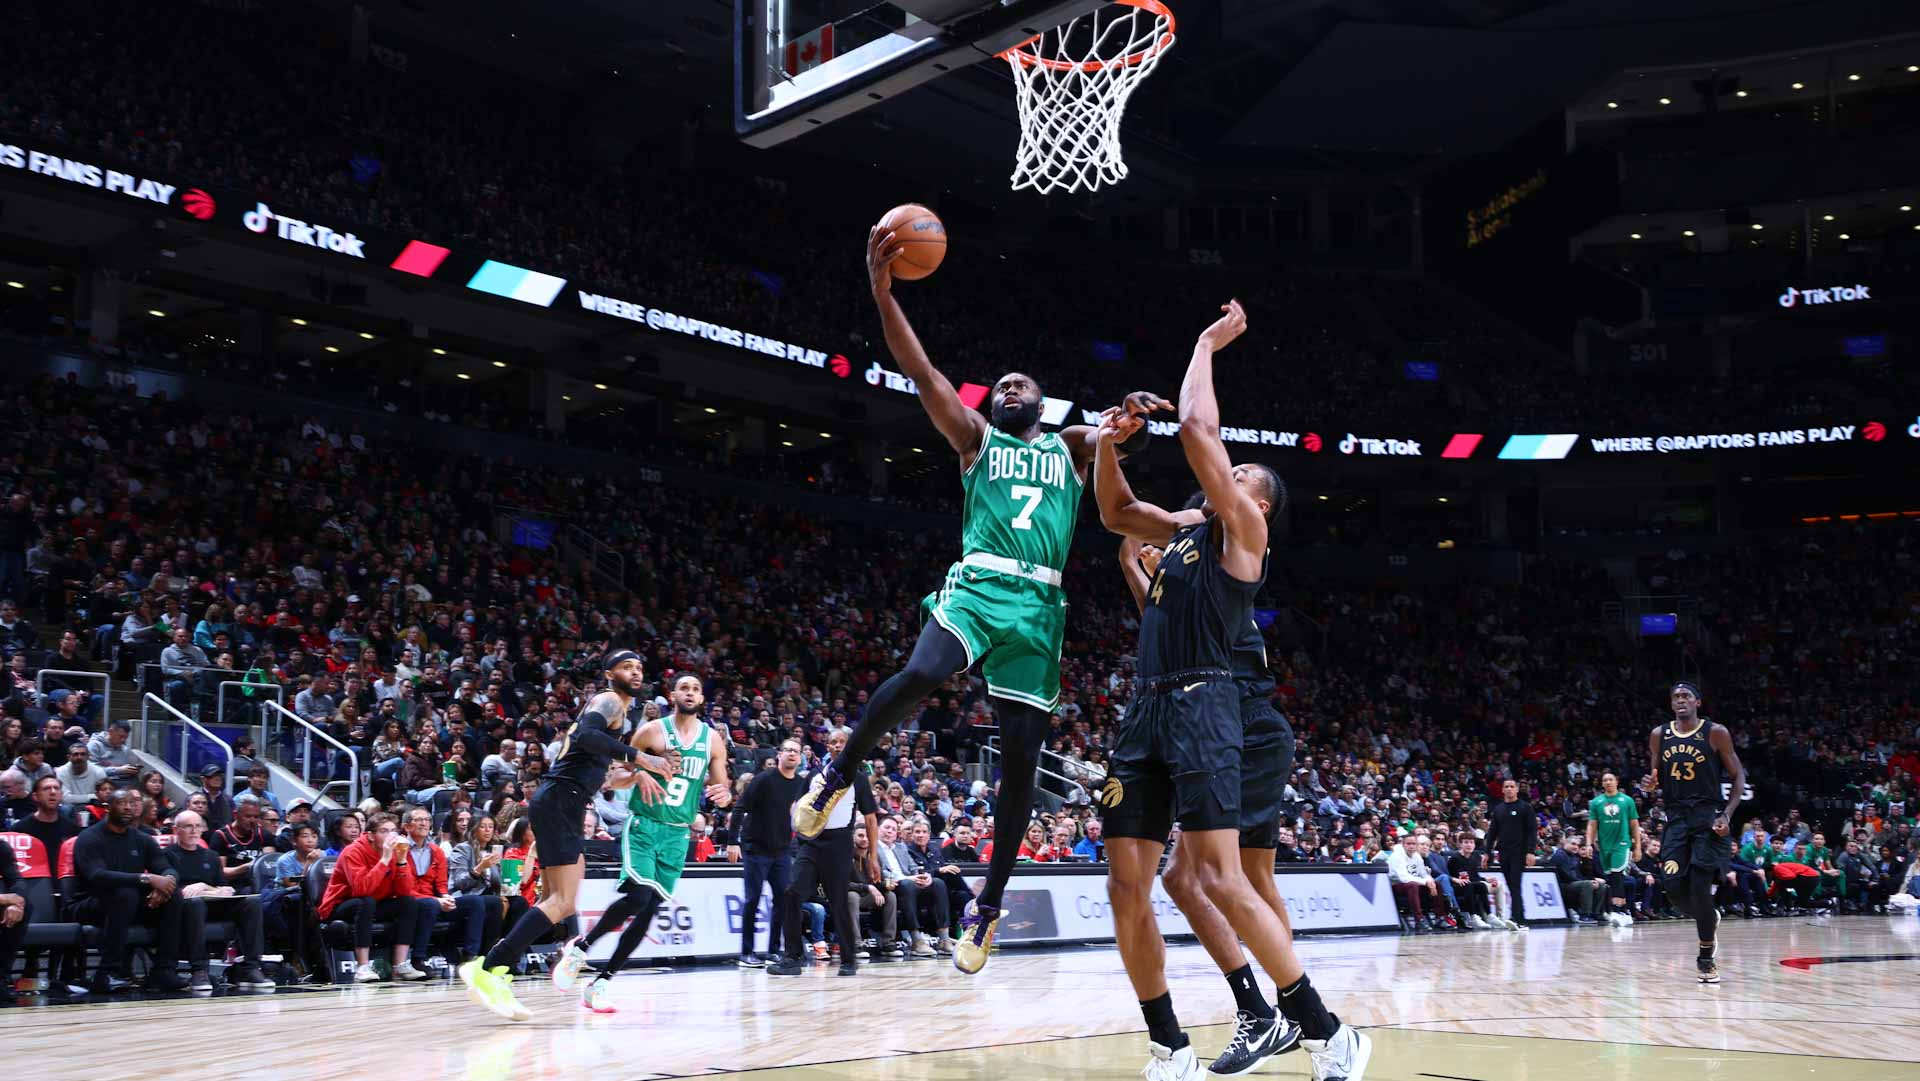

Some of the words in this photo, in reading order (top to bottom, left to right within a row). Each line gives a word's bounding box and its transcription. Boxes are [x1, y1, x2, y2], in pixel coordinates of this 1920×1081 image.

[29, 150, 103, 188] FANS
[105, 170, 176, 206] PLAY
[276, 213, 366, 259] TikTok
[1801, 284, 1871, 305] TikTok
[578, 290, 646, 324] WHERE
[646, 308, 744, 346] @RAPTORS
[745, 332, 786, 358] FANS
[787, 345, 828, 368] PLAY
[1220, 426, 1259, 444] FANS
[1260, 430, 1299, 447] PLAY
[1359, 438, 1422, 456] TikTok
[1592, 436, 1653, 453] WHERE
[1656, 433, 1755, 453] @RAPTORS
[1759, 430, 1805, 446] FANS
[1808, 425, 1856, 442] PLAY
[989, 447, 1066, 490] BOSTON
[1011, 485, 1043, 530] 7
[1151, 568, 1167, 605] 4
[1662, 744, 1706, 764] TORONTO
[1670, 762, 1697, 781] 43
[664, 777, 689, 807] 9
[657, 906, 693, 931] 5G
[659, 933, 695, 945] VIEW
